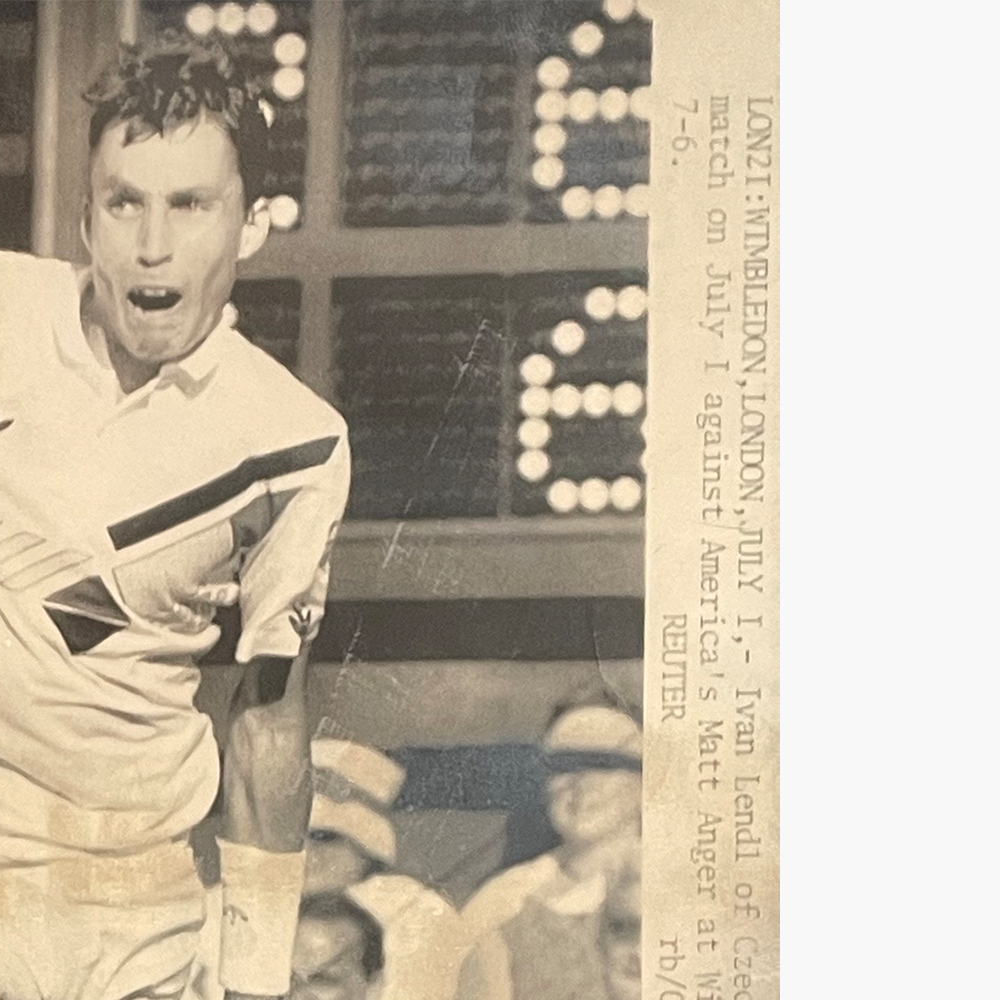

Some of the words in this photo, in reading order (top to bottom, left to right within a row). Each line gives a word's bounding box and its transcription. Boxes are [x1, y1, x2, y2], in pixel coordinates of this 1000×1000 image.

[672, 99, 698, 167] 7-6.
[708, 95, 734, 189] match
[707, 208, 728, 244] on
[699, 263, 732, 339] July
[699, 539, 726, 701] America's
[662, 614, 687, 722] REUTER
[698, 720, 724, 791] Matt
[735, 687, 761, 756] Ivan
[691, 810, 723, 900] Anger
[735, 776, 761, 862] Lendl
[698, 919, 719, 954] at
[734, 883, 760, 920] of
